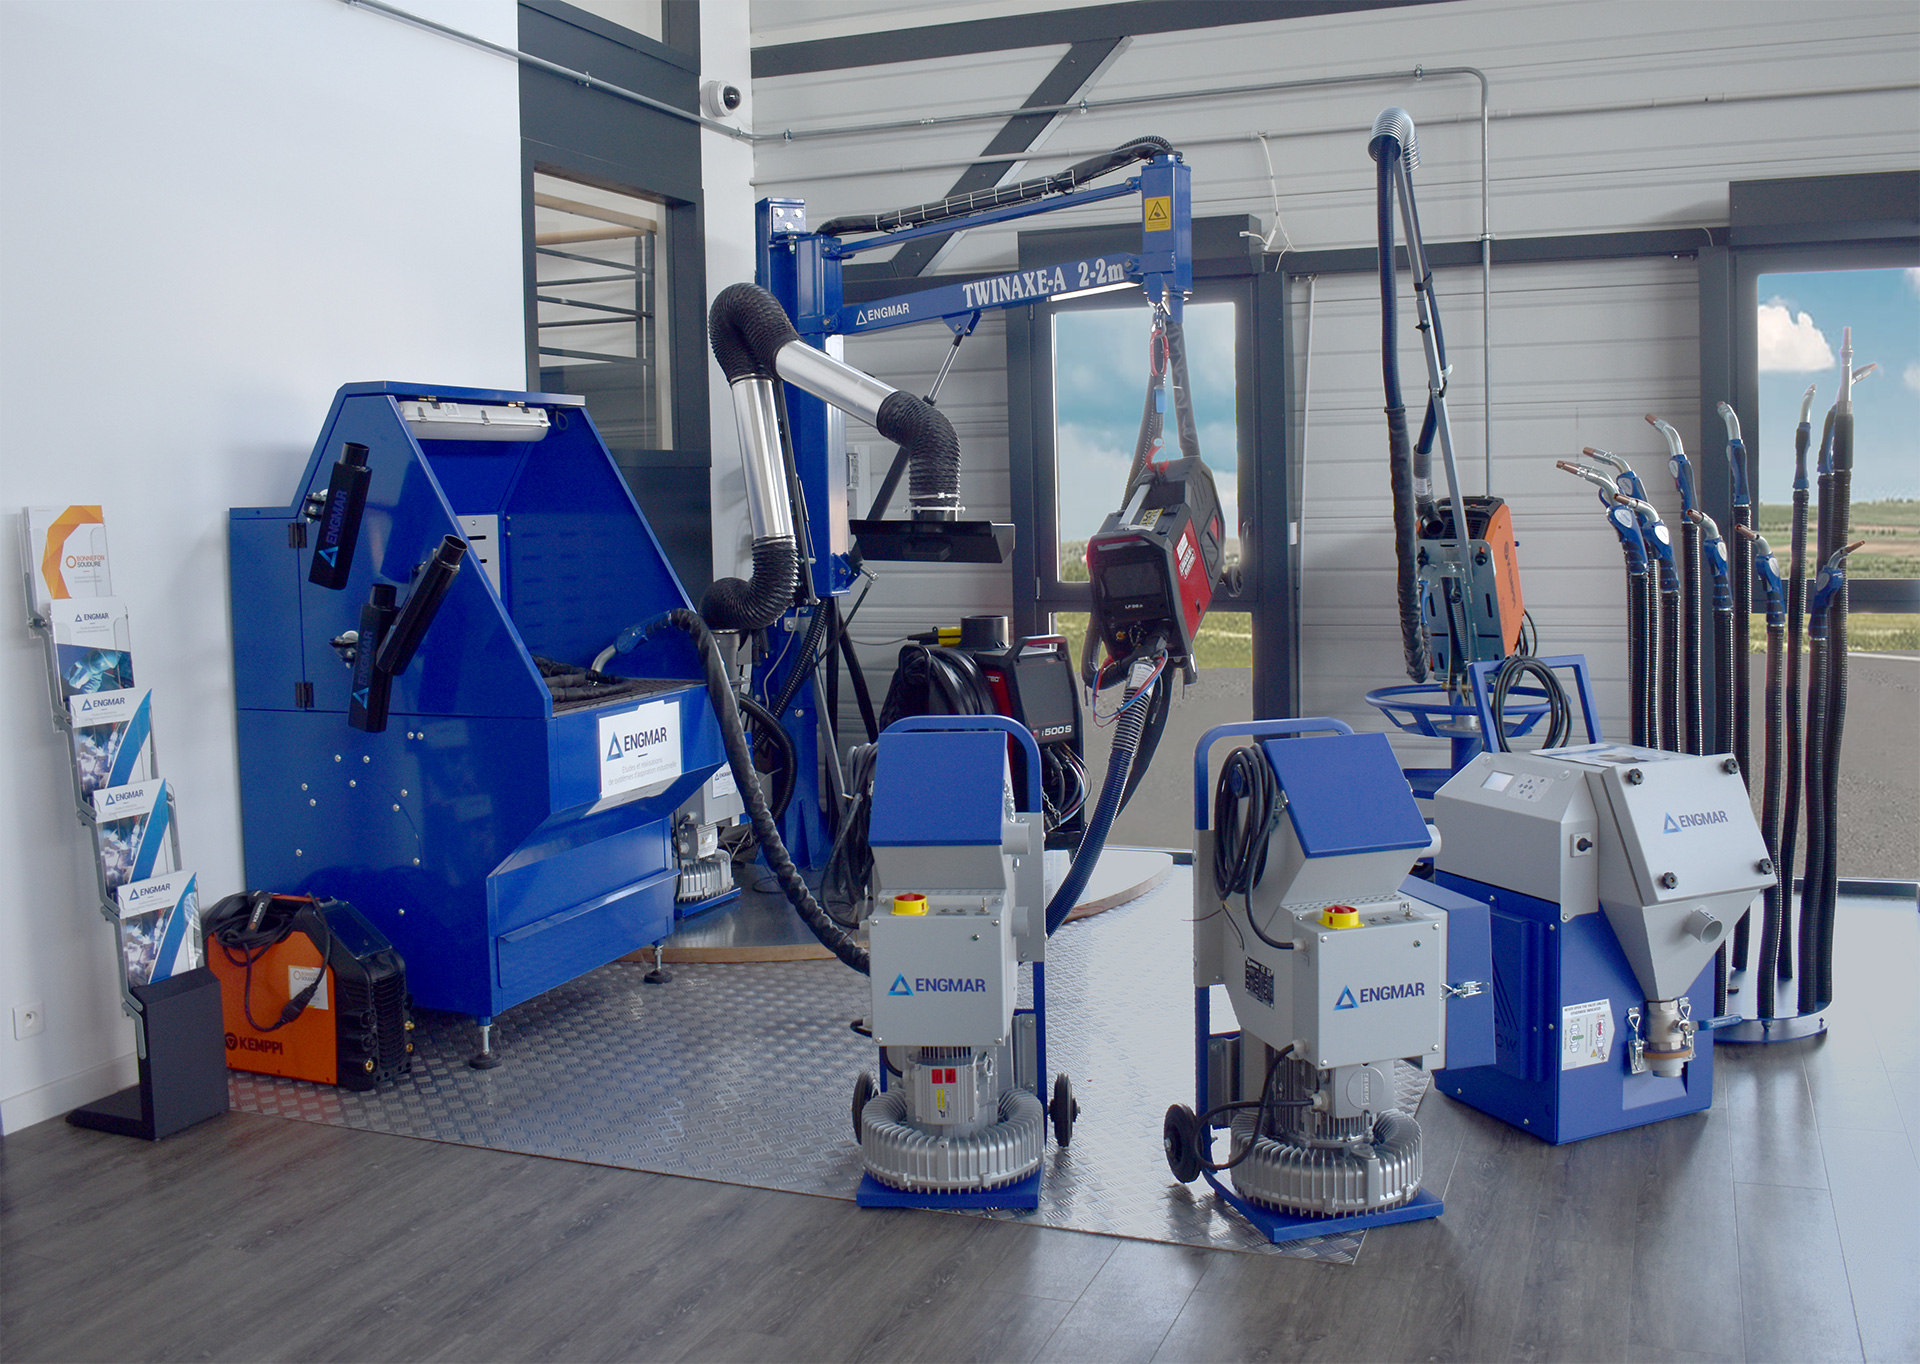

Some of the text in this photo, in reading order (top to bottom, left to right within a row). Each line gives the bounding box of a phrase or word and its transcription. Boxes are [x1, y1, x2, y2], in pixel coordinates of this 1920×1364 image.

[962, 258, 1124, 308] TWINAXE-A 2-2m
[867, 302, 910, 322] ENGMAR
[325, 489, 348, 545] ENGMAR
[83, 612, 109, 621] ENGMAR
[357, 630, 373, 687] ENGMAR
[93, 697, 125, 708] ENGMAR
[624, 726, 667, 752] ENGMAR
[115, 789, 144, 802] ENGMAR
[1679, 809, 1729, 828] ENGMAR
[140, 883, 171, 896] ENGMAR
[252, 901, 265, 923] KEMPPI
[915, 978, 986, 993] ENGMAR
[1359, 981, 1426, 1004] ENGMAR
[239, 1036, 284, 1055] KEMPPI
